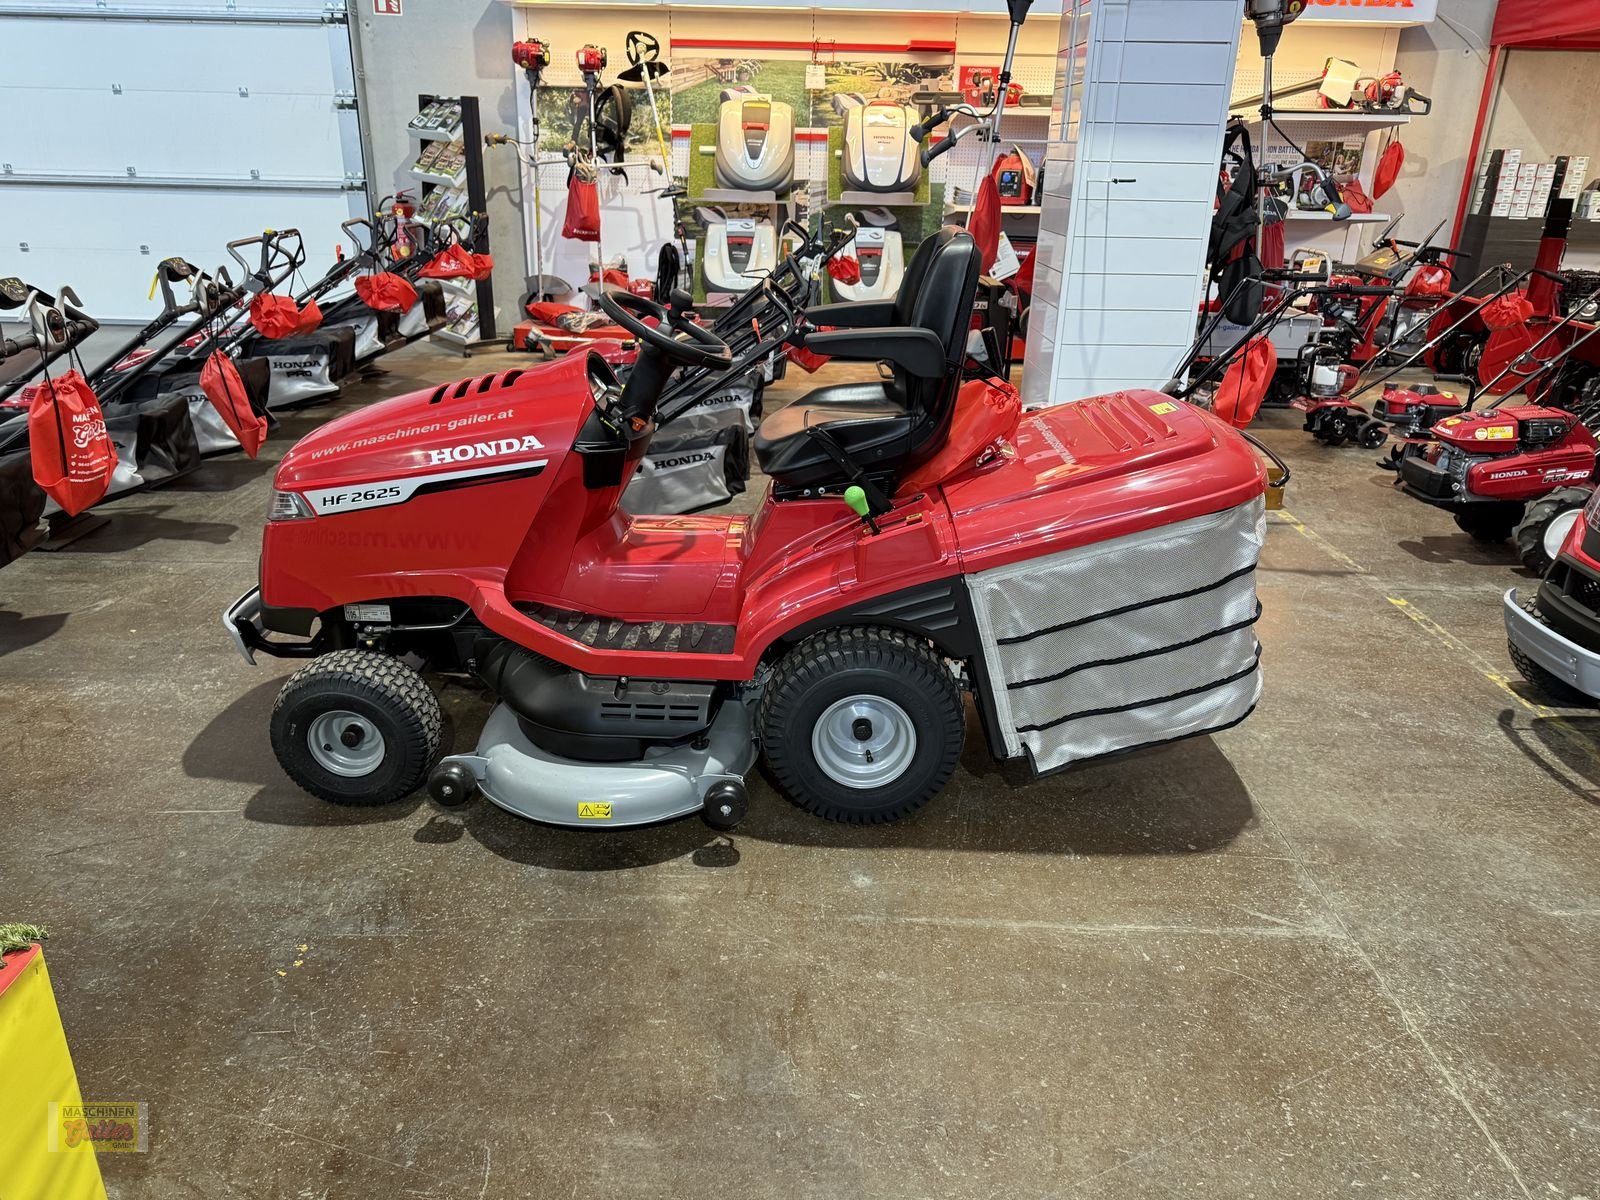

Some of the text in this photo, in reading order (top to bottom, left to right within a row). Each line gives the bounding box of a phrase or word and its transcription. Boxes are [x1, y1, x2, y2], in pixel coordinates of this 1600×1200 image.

[272, 360, 322, 369] HONDA
[286, 370, 313, 378] PRO
[311, 408, 514, 460] www.maschinen-gailer.at
[428, 435, 545, 465] HONDA
[653, 452, 716, 471] HONDA
[1490, 469, 1529, 480] HONDA
[322, 486, 401, 507] HF 2625
